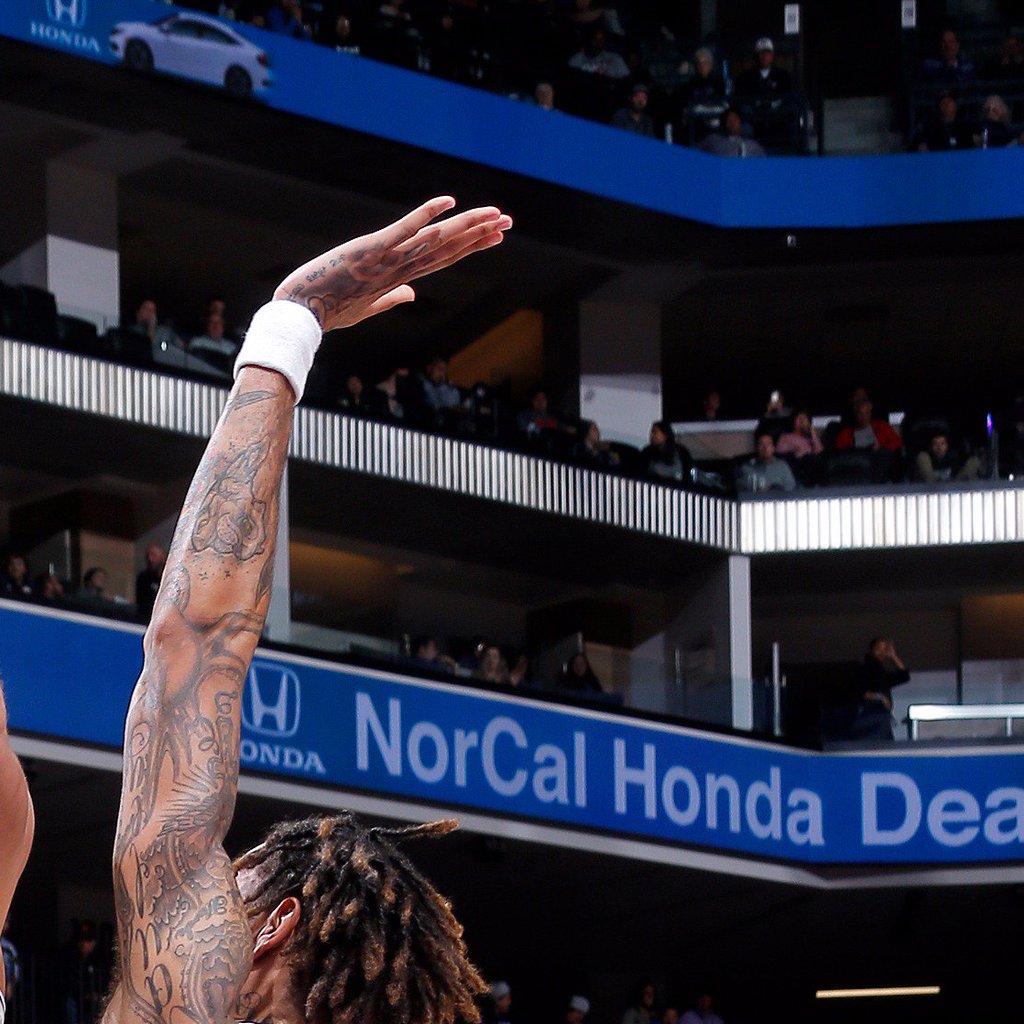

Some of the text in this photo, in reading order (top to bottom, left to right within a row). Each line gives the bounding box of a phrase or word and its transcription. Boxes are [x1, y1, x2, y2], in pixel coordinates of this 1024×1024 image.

[30, 22, 101, 53] HONDA
[239, 739, 326, 774] ONDA
[355, 691, 588, 808] NorCal
[613, 737, 825, 846] Honda
[861, 771, 1024, 847] Dea
